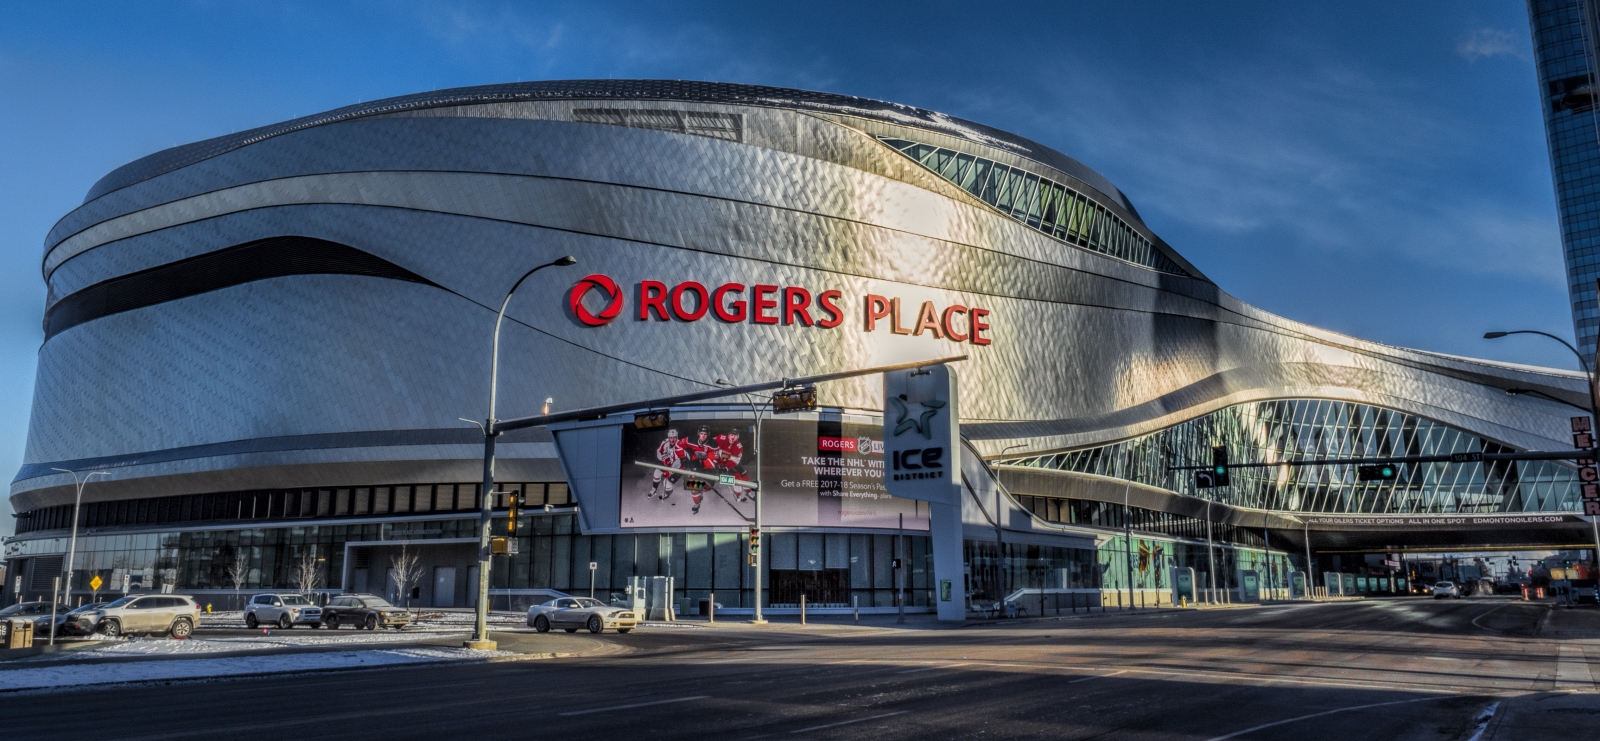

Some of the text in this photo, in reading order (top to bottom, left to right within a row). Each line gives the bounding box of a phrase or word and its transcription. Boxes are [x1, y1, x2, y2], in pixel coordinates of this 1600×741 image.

[638, 279, 992, 345] ROGERS PLACE
[822, 439, 854, 449] ROGERS
[801, 456, 826, 465] TAKE
[828, 457, 845, 466] THE
[868, 459, 884, 468] WIT
[1571, 416, 1600, 515] MECER
[814, 467, 881, 478] WHEREVER YOU
[893, 471, 943, 481] DISTRICT
[820, 480, 848, 488] 2017-18
[850, 482, 876, 490] Season's
